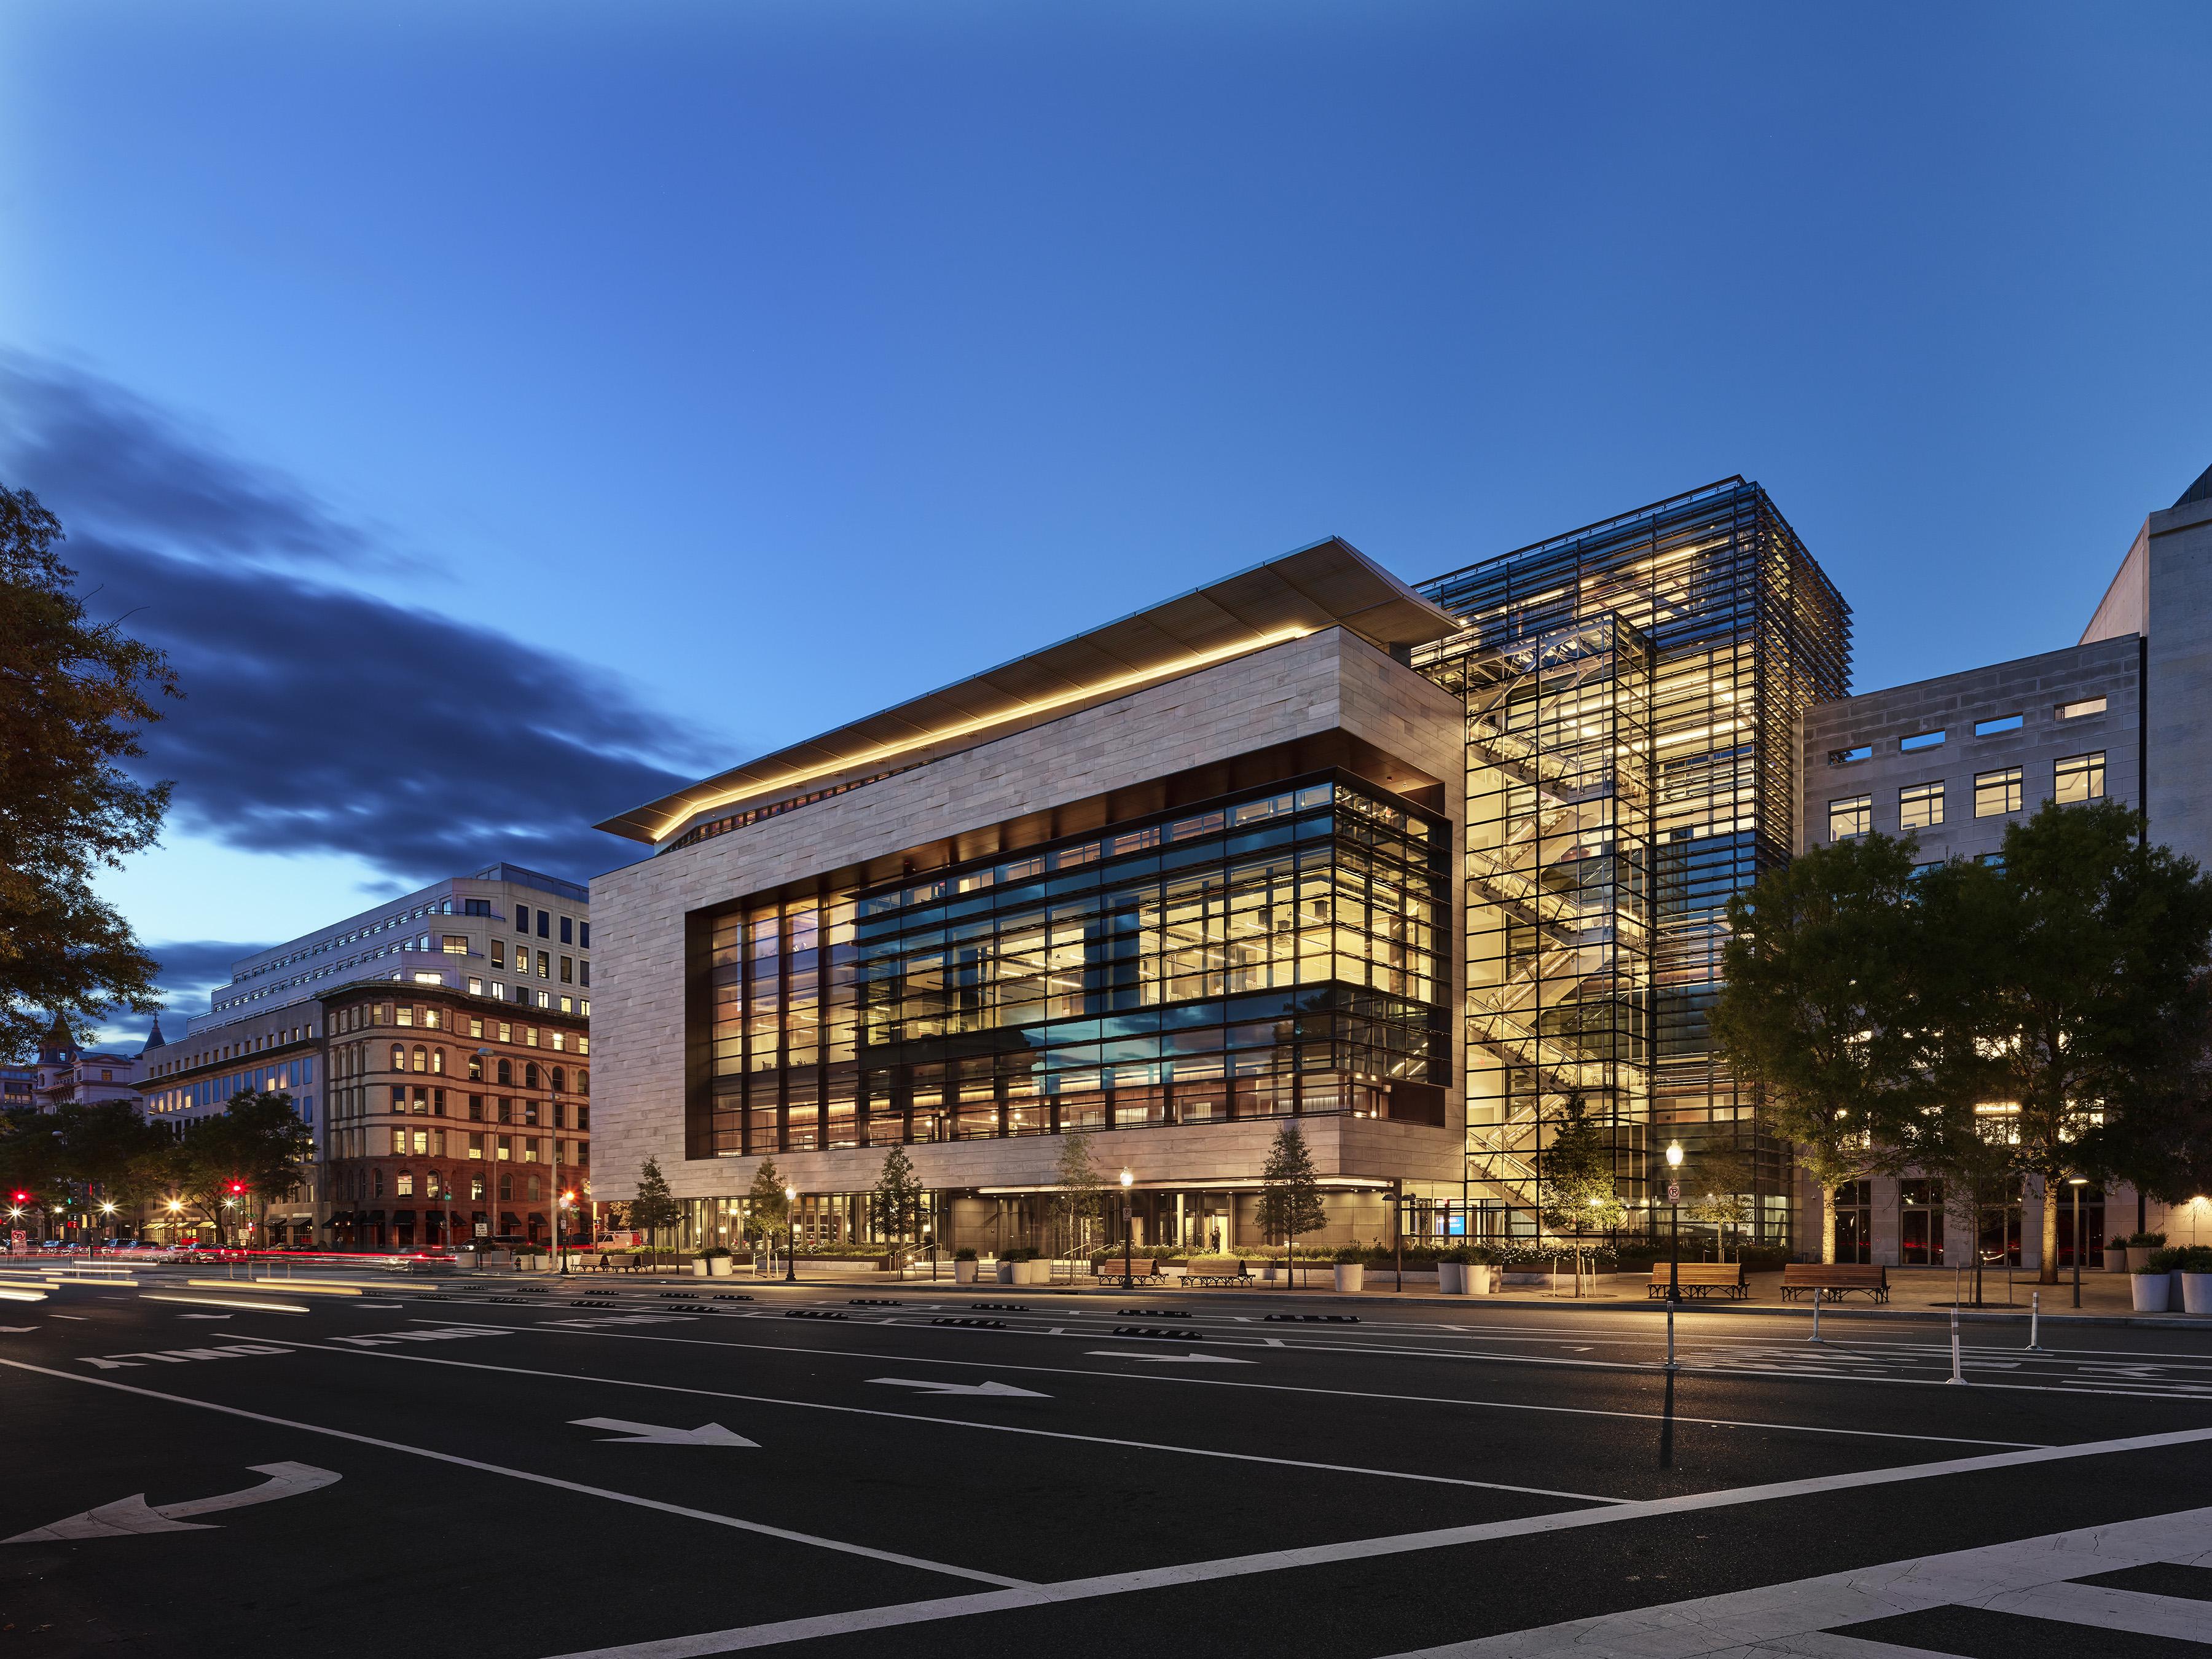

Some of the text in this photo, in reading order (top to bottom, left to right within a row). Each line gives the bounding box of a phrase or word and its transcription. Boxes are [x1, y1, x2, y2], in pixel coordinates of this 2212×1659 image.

[533, 1315, 700, 1328] ONLY
[324, 1327, 516, 1346] ONLY
[74, 1344, 297, 1369] ONLY
